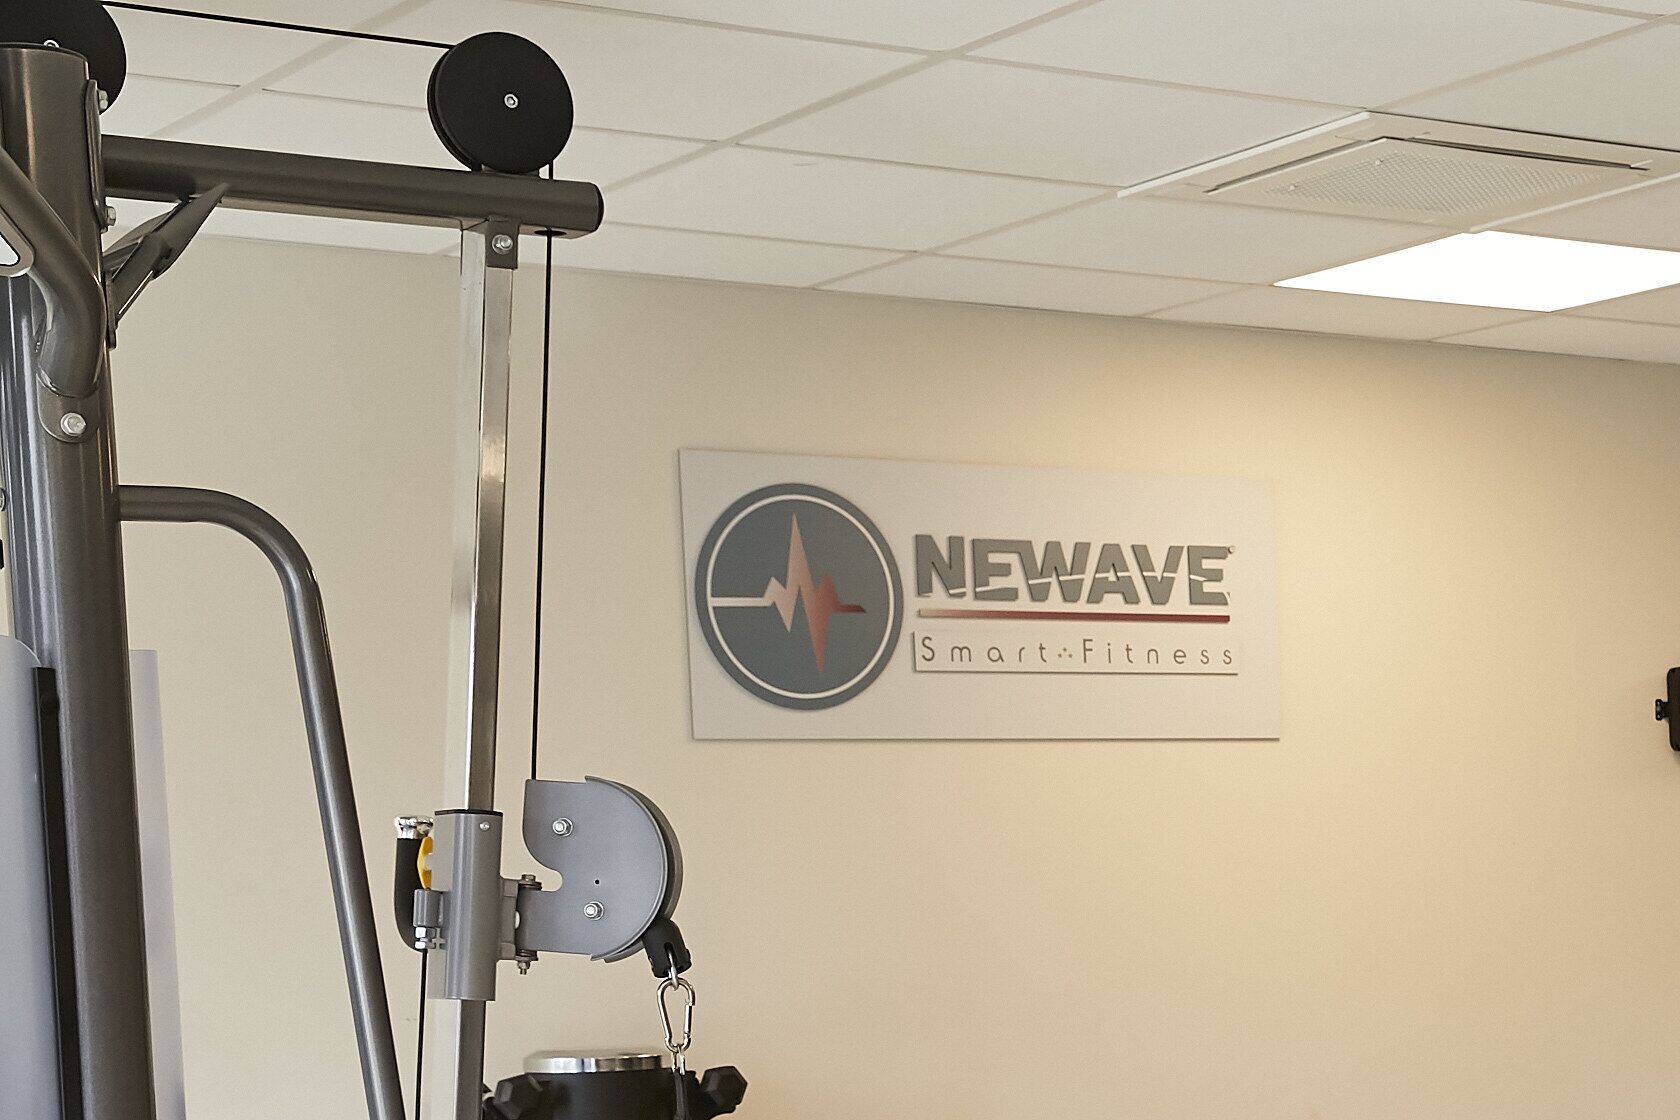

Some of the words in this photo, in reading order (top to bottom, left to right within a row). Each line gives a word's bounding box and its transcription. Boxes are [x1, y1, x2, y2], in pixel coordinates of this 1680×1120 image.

[915, 533, 1232, 605] NEWAVE
[921, 636, 1047, 663] Smart
[1082, 638, 1232, 665] Fitness
